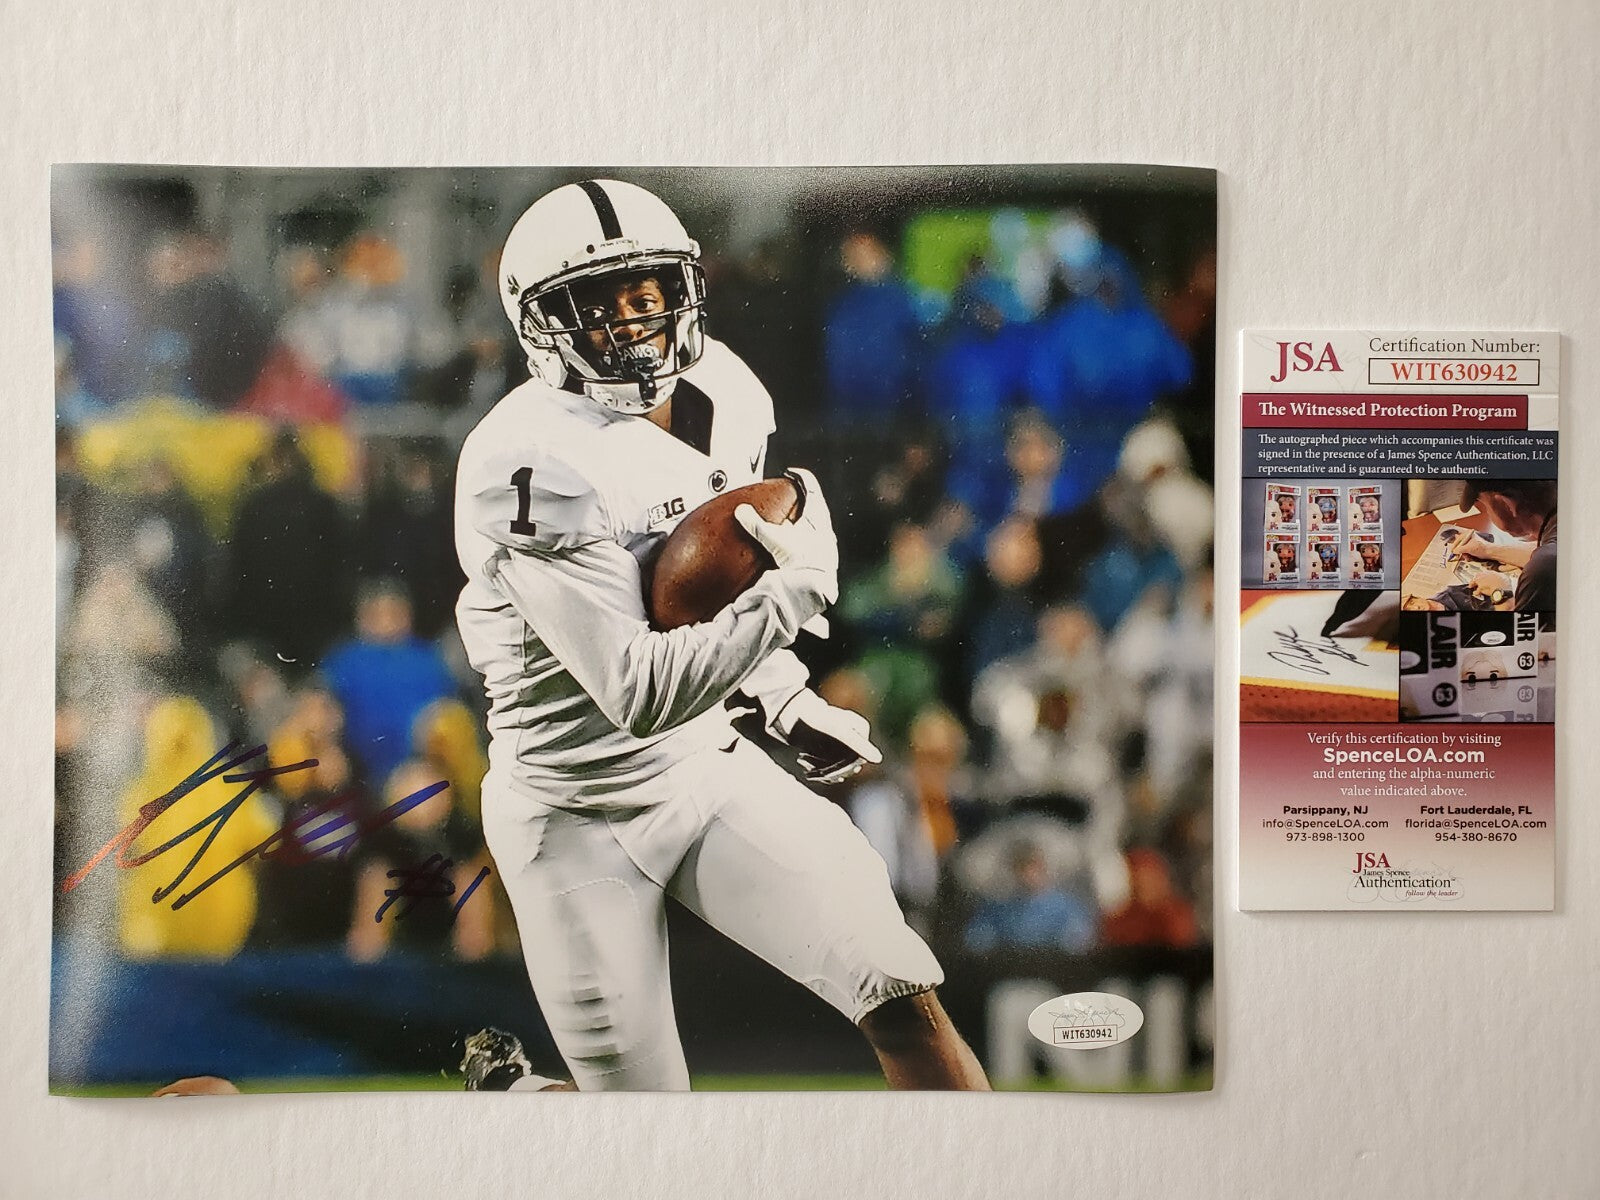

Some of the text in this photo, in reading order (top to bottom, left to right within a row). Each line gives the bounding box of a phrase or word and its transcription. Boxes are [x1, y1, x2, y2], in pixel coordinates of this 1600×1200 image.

[1369, 337, 1540, 353] Certification Number:
[1270, 341, 1344, 383] JSA
[1390, 362, 1517, 382] WIT630942
[1258, 402, 1517, 421] The Witnessed Protection Program
[1258, 434, 1554, 447] The autographed piece which accompanies this certificate was
[1258, 449, 1290, 460] signed
[1292, 449, 1302, 459] in
[1305, 449, 1321, 459] the
[1323, 451, 1365, 461] presence
[1367, 449, 1379, 459] of
[1387, 449, 1416, 460] James
[1418, 450, 1453, 461] Spence
[1455, 450, 1530, 461] Authentication,
[1532, 450, 1554, 461] LLC
[1258, 464, 1489, 476] representative and is guaranteed to be authentic.
[510, 466, 536, 537] 1
[1518, 654, 1534, 668] 63
[1307, 732, 1502, 747] Verify this certification by visiting
[1323, 747, 1485, 765] SpenceLOA.com
[1313, 767, 1496, 782] and entering the alpha-numeric
[1340, 784, 1467, 796] value indicated above.
[1283, 805, 1369, 816] Parsippany, NJ
[1420, 805, 1532, 816] Fort Lauderdale, FL
[1262, 818, 1389, 829] info@SpenceLOA.com
[1405, 818, 1547, 829] florida@SpenceLOA.com
[1286, 832, 1365, 841] 973-898-1300
[1435, 832, 1517, 841] 954-380-8670
[1352, 852, 1391, 873] JSA
[1363, 868, 1411, 877] James Spence
[1405, 889, 1459, 897] follow the leader
[1062, 1028, 1112, 1039] WIT630942
